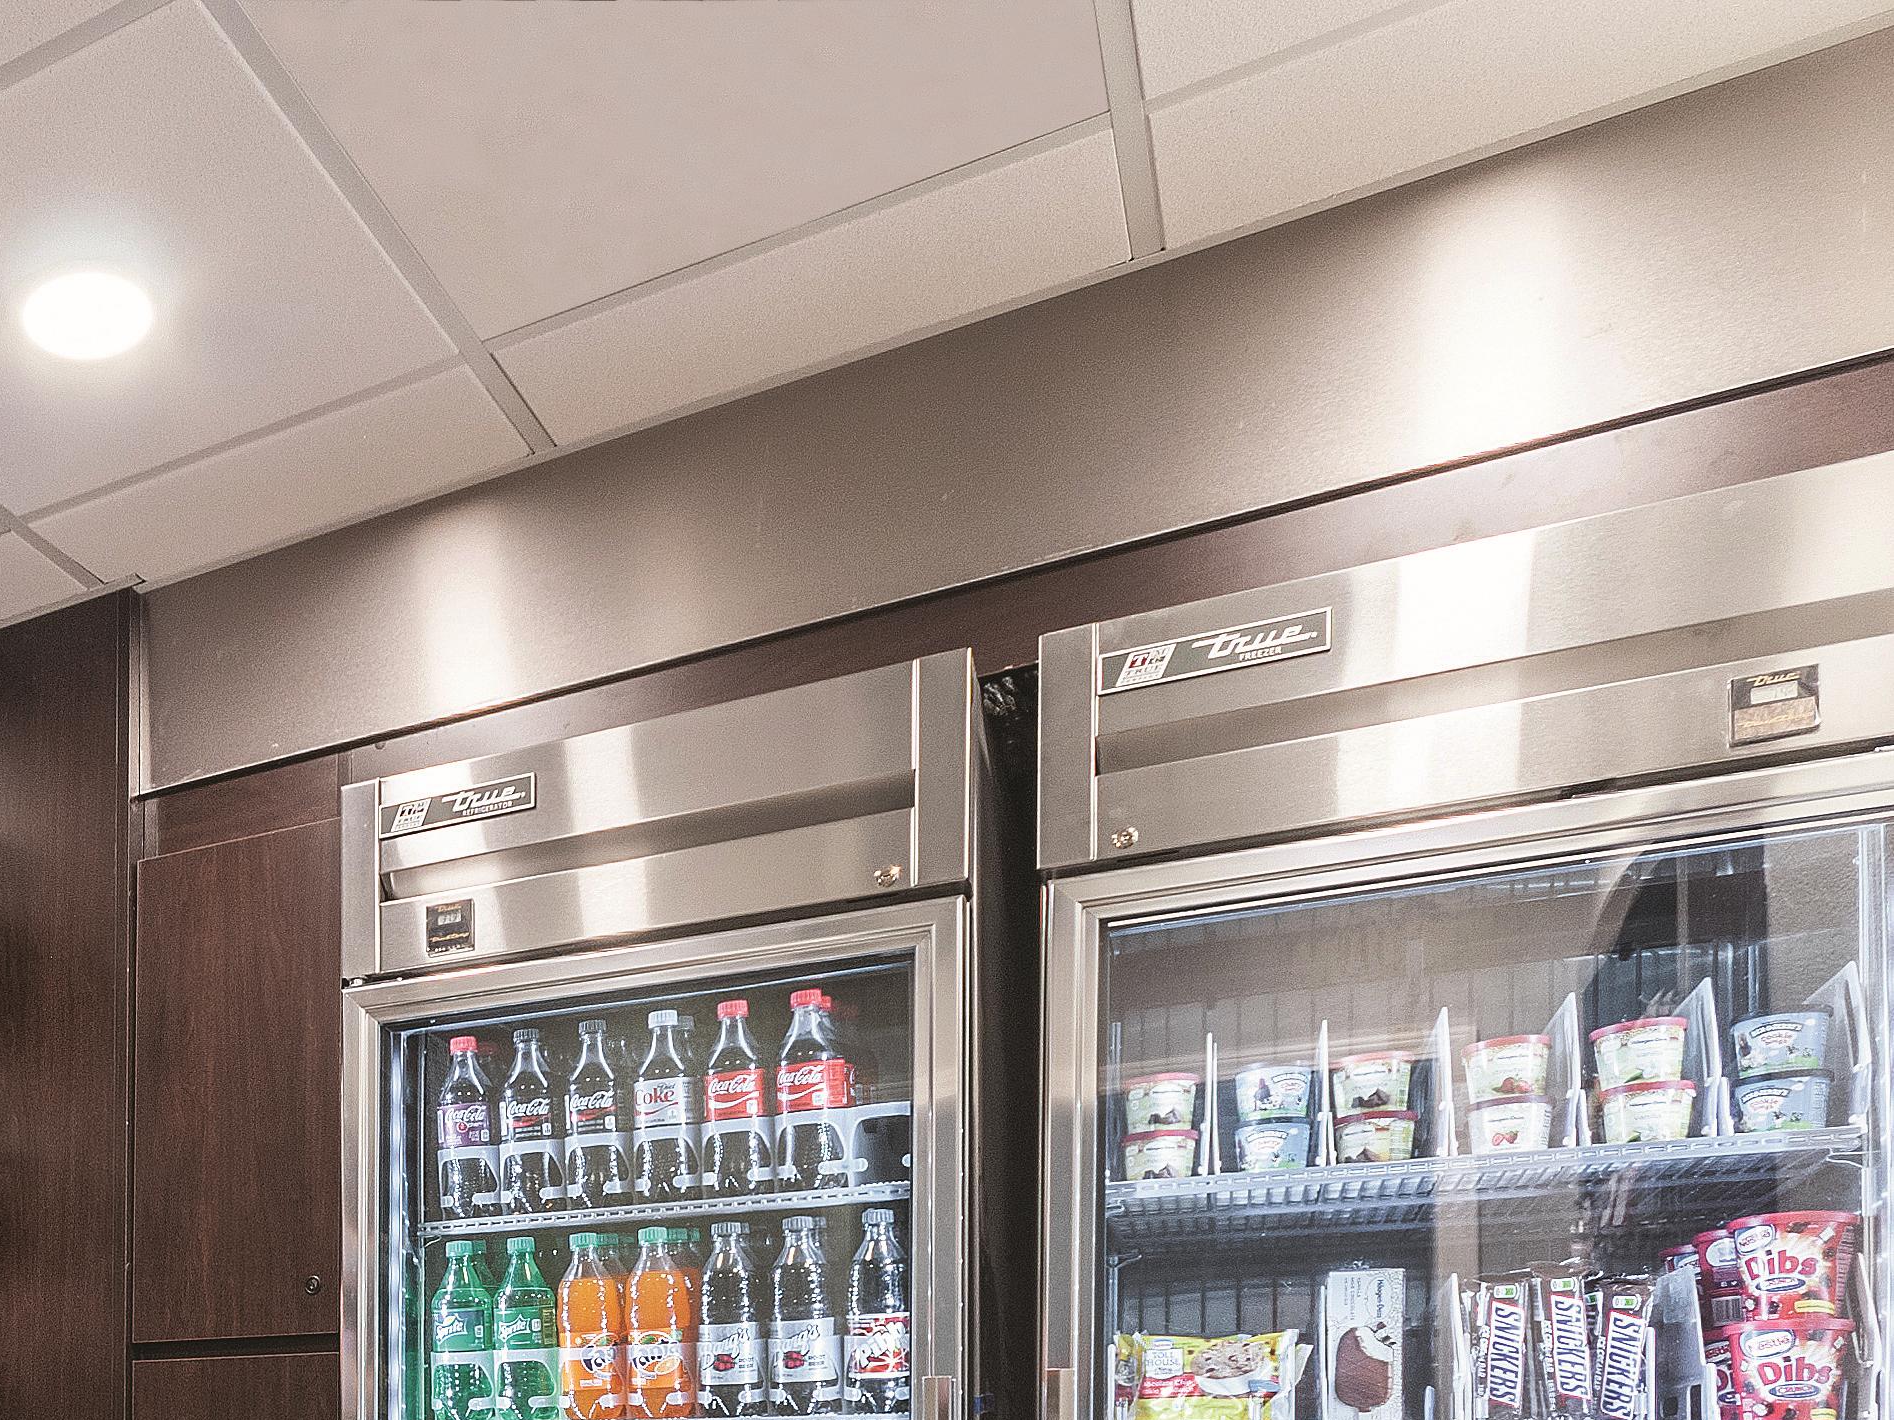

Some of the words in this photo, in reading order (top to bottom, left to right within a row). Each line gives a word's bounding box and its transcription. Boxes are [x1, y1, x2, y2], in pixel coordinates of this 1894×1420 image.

[1239, 646, 1282, 661] FREEZER
[462, 801, 513, 816] REFRIGERATOR
[635, 1087, 675, 1106] Coke
[1745, 1248, 1818, 1279] Dibs
[436, 1322, 465, 1341] Sprite
[498, 1321, 527, 1339] Sprite
[1151, 1350, 1175, 1360] TOLL
[1490, 1305, 1524, 1406] SNICKERS
[1552, 1297, 1589, 1398] SNICKERS
[1603, 1315, 1642, 1419] SNICKERS
[1757, 1360, 1832, 1387] Dibs
